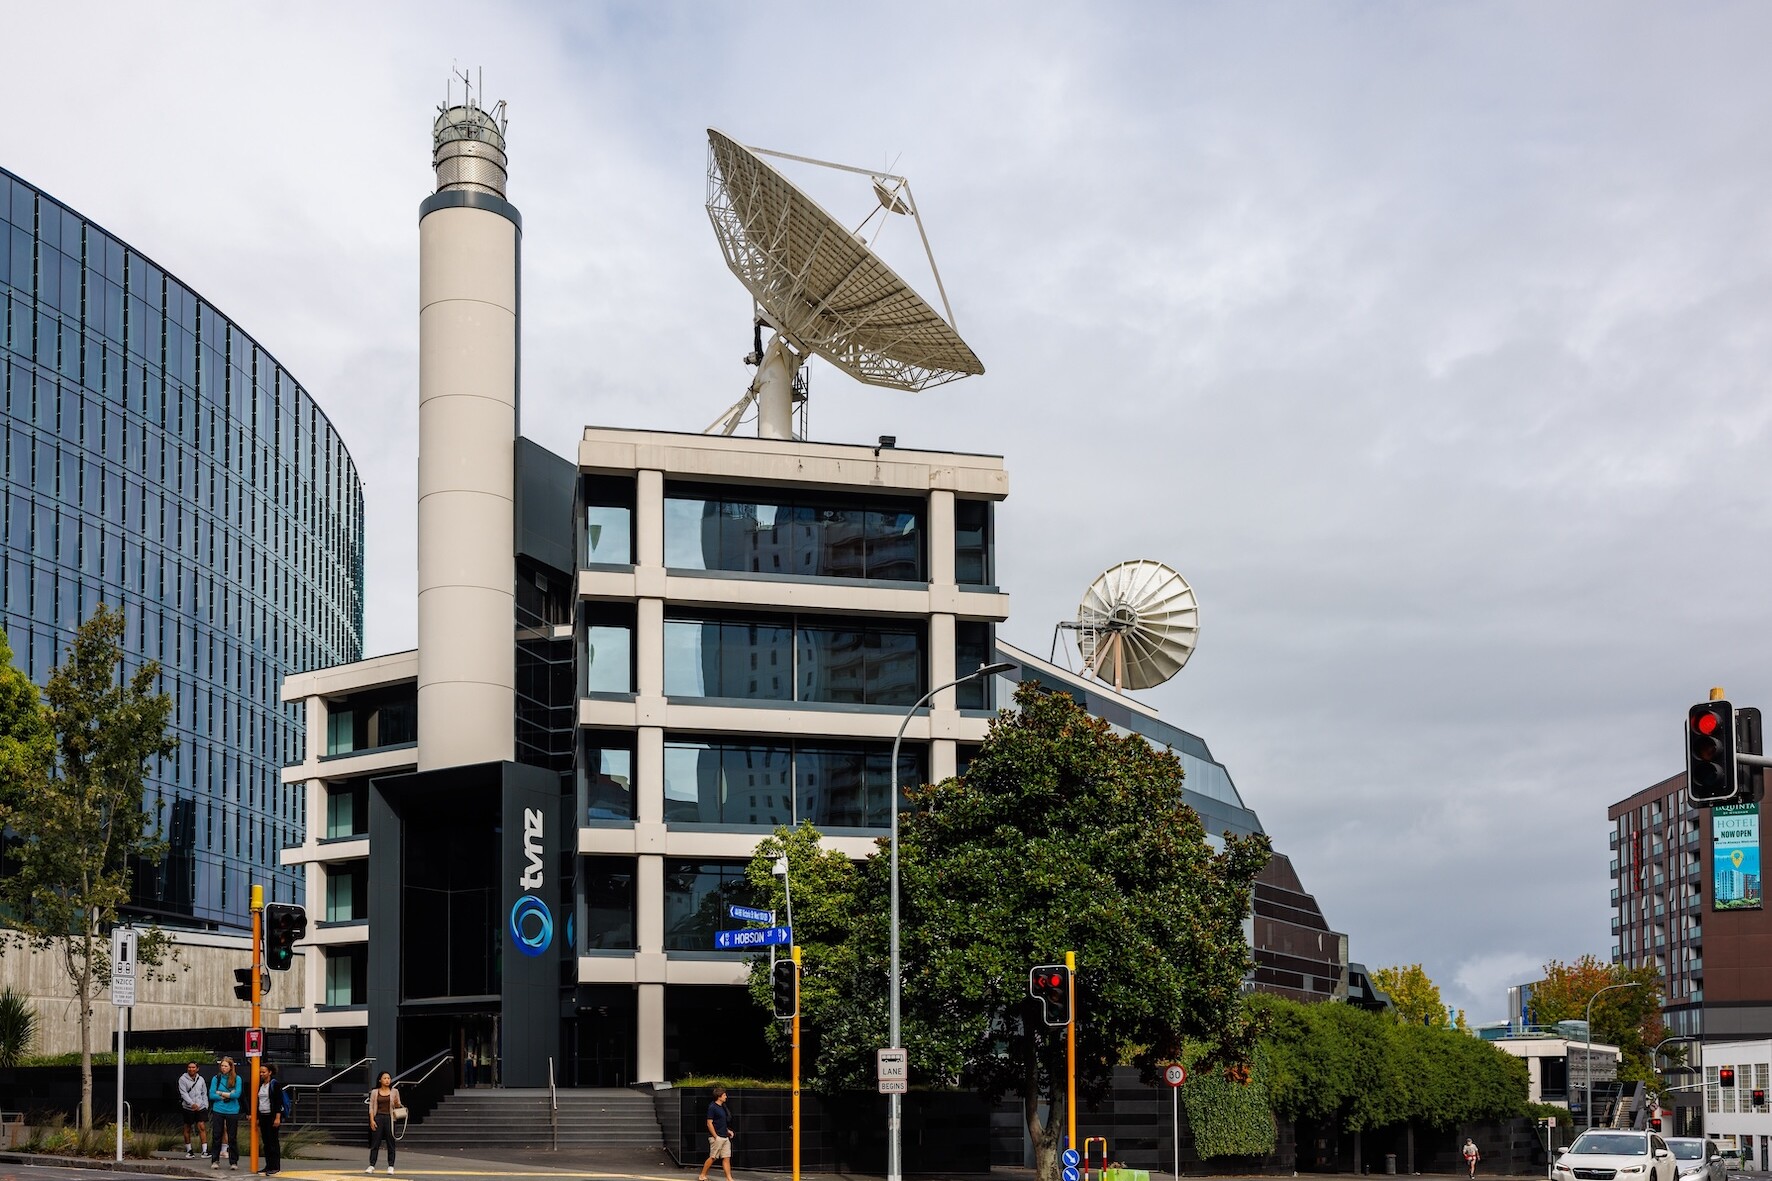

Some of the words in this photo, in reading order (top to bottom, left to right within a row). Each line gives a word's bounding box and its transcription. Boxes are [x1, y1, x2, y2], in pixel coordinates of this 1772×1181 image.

[1717, 818, 1756, 828] HOTEL
[1720, 830, 1735, 839] NOW
[1735, 829, 1752, 838] OPEN
[519, 807, 544, 892] tvnz
[734, 932, 765, 945] HOBSON
[115, 978, 132, 986] NZICC
[882, 1067, 903, 1076] LANE
[1169, 1070, 1180, 1080] 30
[881, 1082, 905, 1090] BEGINS
